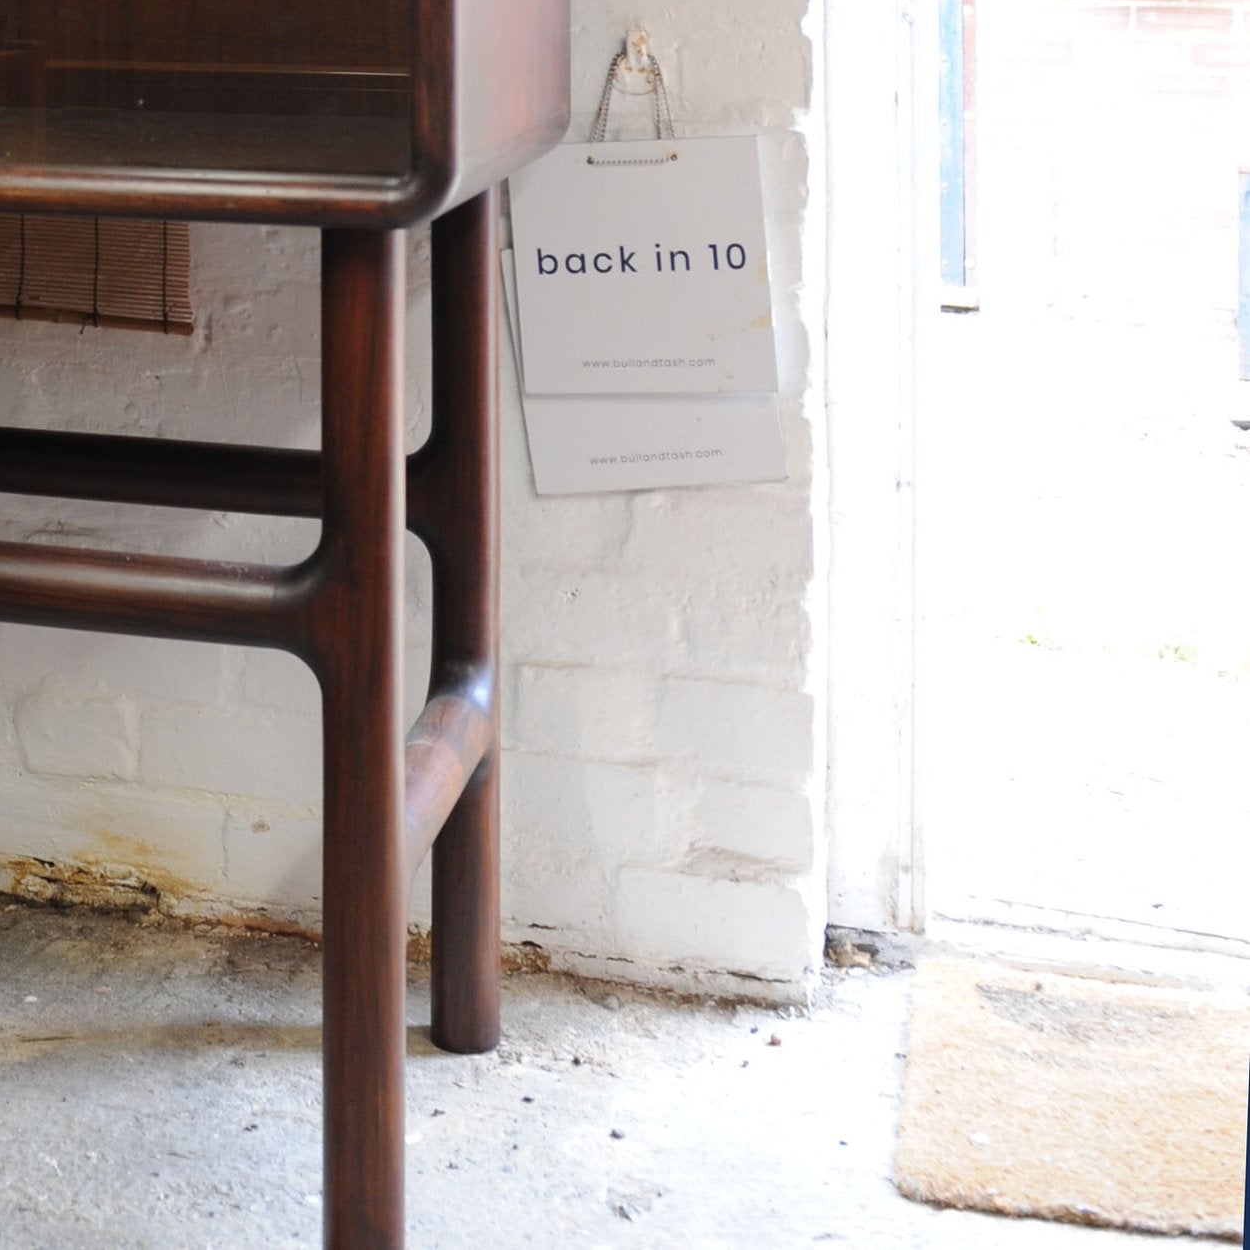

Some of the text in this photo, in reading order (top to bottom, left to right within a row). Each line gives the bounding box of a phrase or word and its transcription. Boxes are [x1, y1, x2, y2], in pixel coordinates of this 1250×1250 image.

[536, 242, 747, 275] back in 10
[581, 357, 716, 369] www.bullandtash.com
[590, 448, 724, 466] www.bullandtash.com
